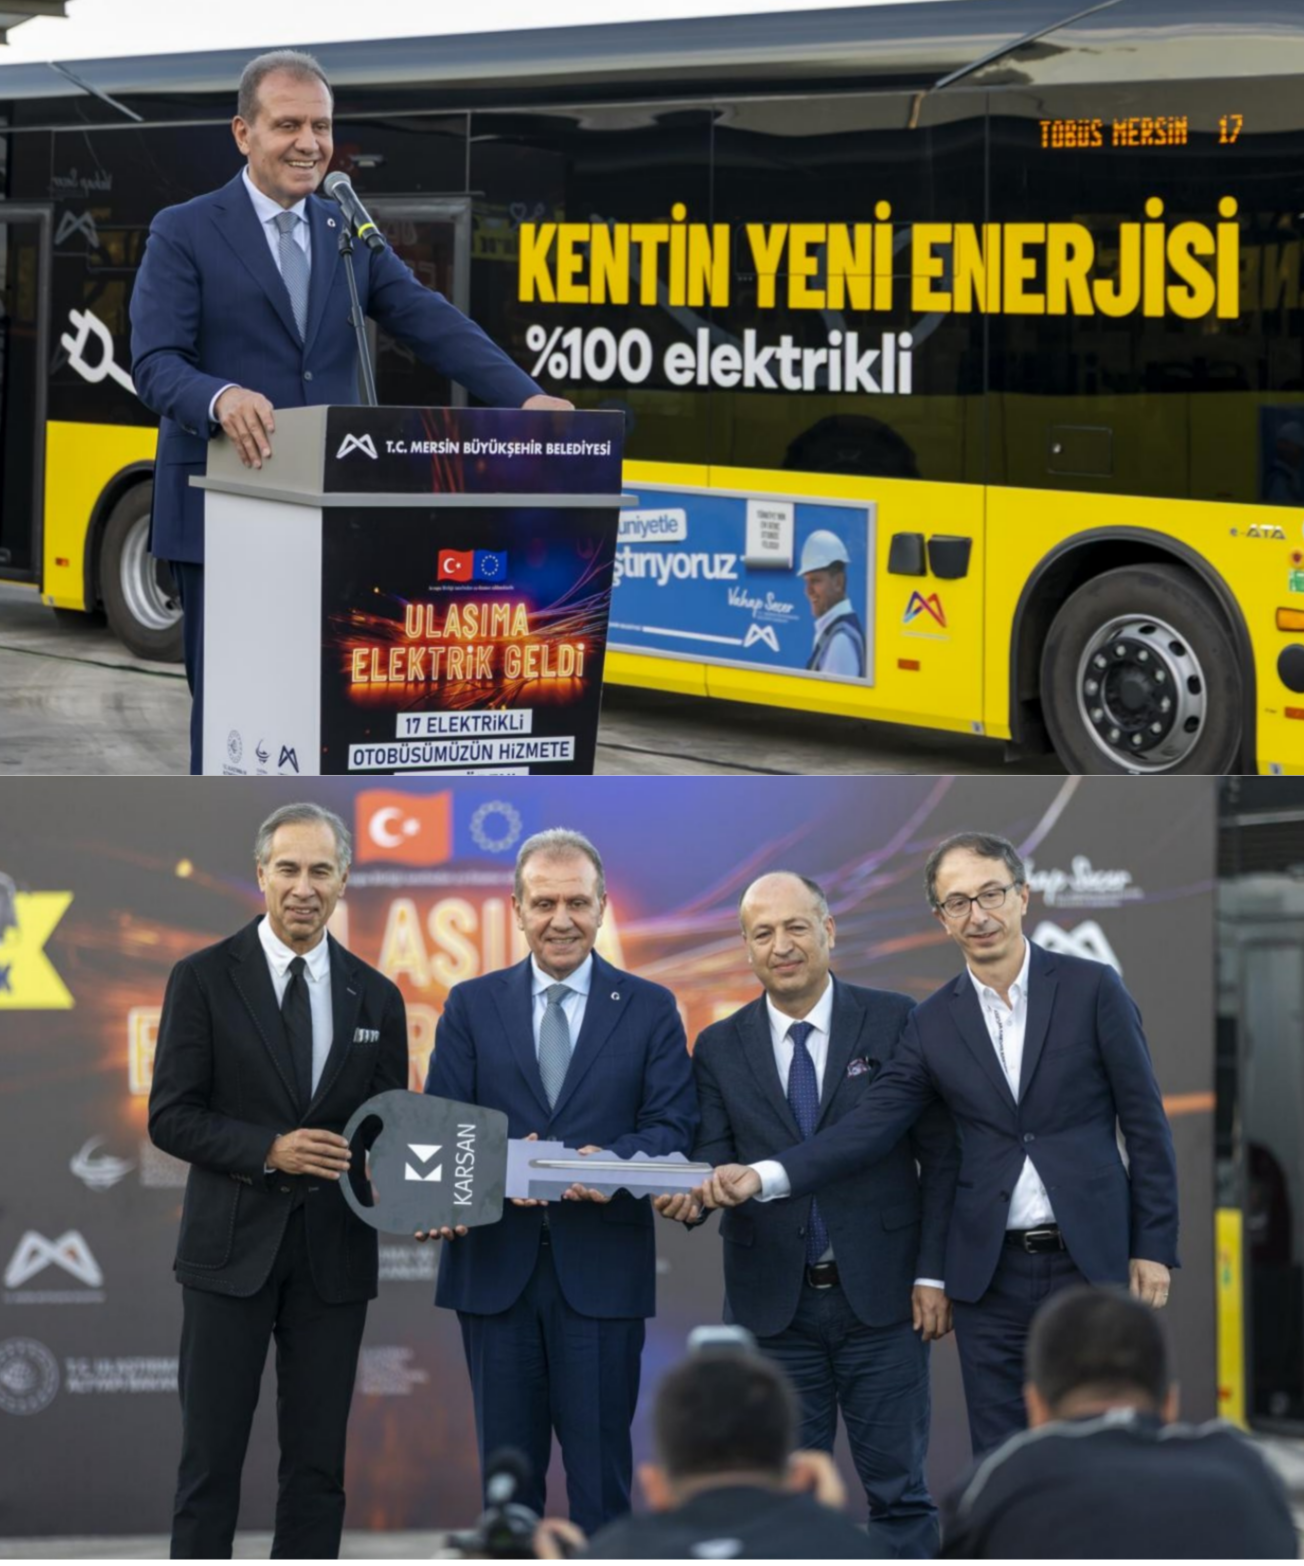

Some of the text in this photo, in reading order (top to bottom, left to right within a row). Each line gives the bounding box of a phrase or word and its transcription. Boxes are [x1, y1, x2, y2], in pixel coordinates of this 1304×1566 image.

[1218, 114, 1243, 144] 17
[518, 202, 730, 307] KENTİN
[746, 200, 893, 311] YENİ
[911, 196, 1239, 319] ENERJİSİ
[525, 324, 912, 394] %100 elektrikli
[386, 438, 612, 458] T.C. MERSİN BÜYÜKŞEHİR BELEDİYESİ
[405, 603, 530, 641] ULAŞIMA
[405, 717, 421, 734] 17
[353, 740, 493, 766] OTOBÜSÜMÜZÜN
[453, 1123, 477, 1206] KARSAN
